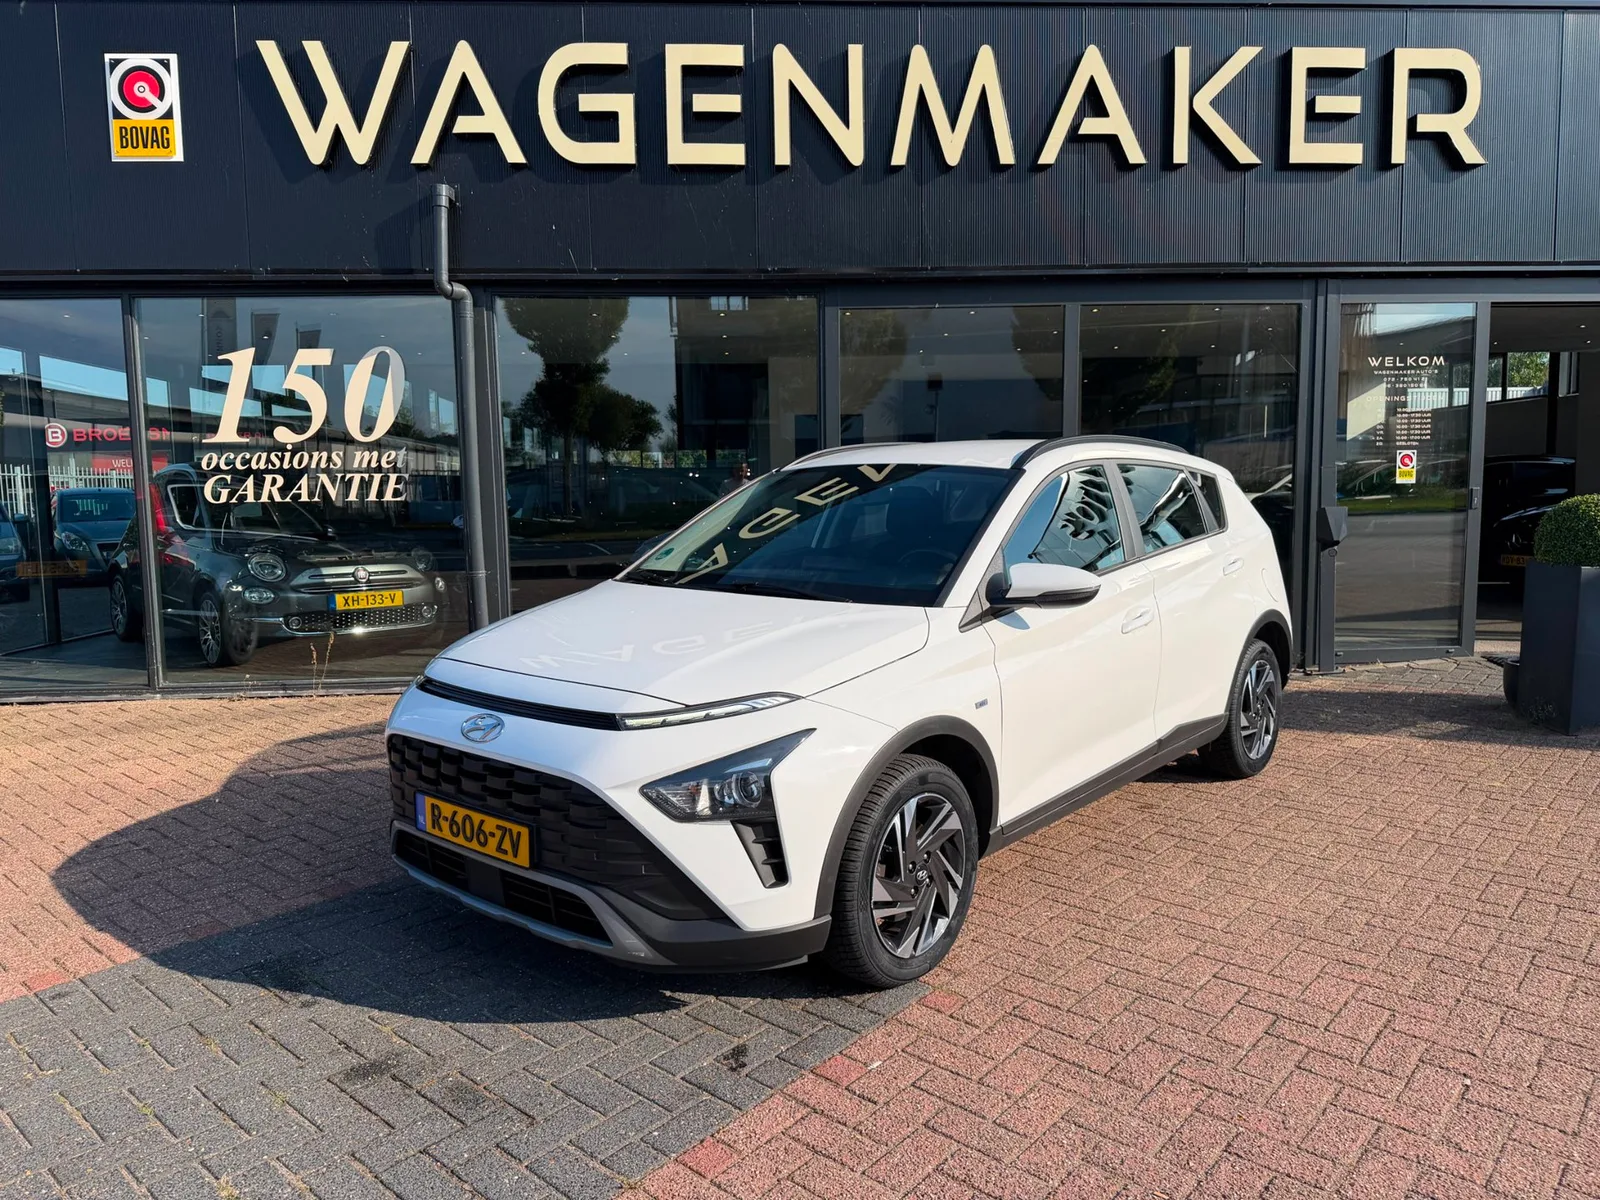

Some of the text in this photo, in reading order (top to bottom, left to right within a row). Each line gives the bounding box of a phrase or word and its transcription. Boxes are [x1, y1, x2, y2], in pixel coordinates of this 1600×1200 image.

[255, 40, 1487, 167] WAGENMAKER
[119, 126, 170, 149] BOVAG
[1367, 356, 1445, 367] WELKOM
[202, 346, 405, 443] 150
[201, 444, 408, 470] occasions met
[203, 473, 409, 504] GARANTIE
[343, 593, 396, 607] XH-133-V
[430, 802, 521, 858] R-606-ZV
